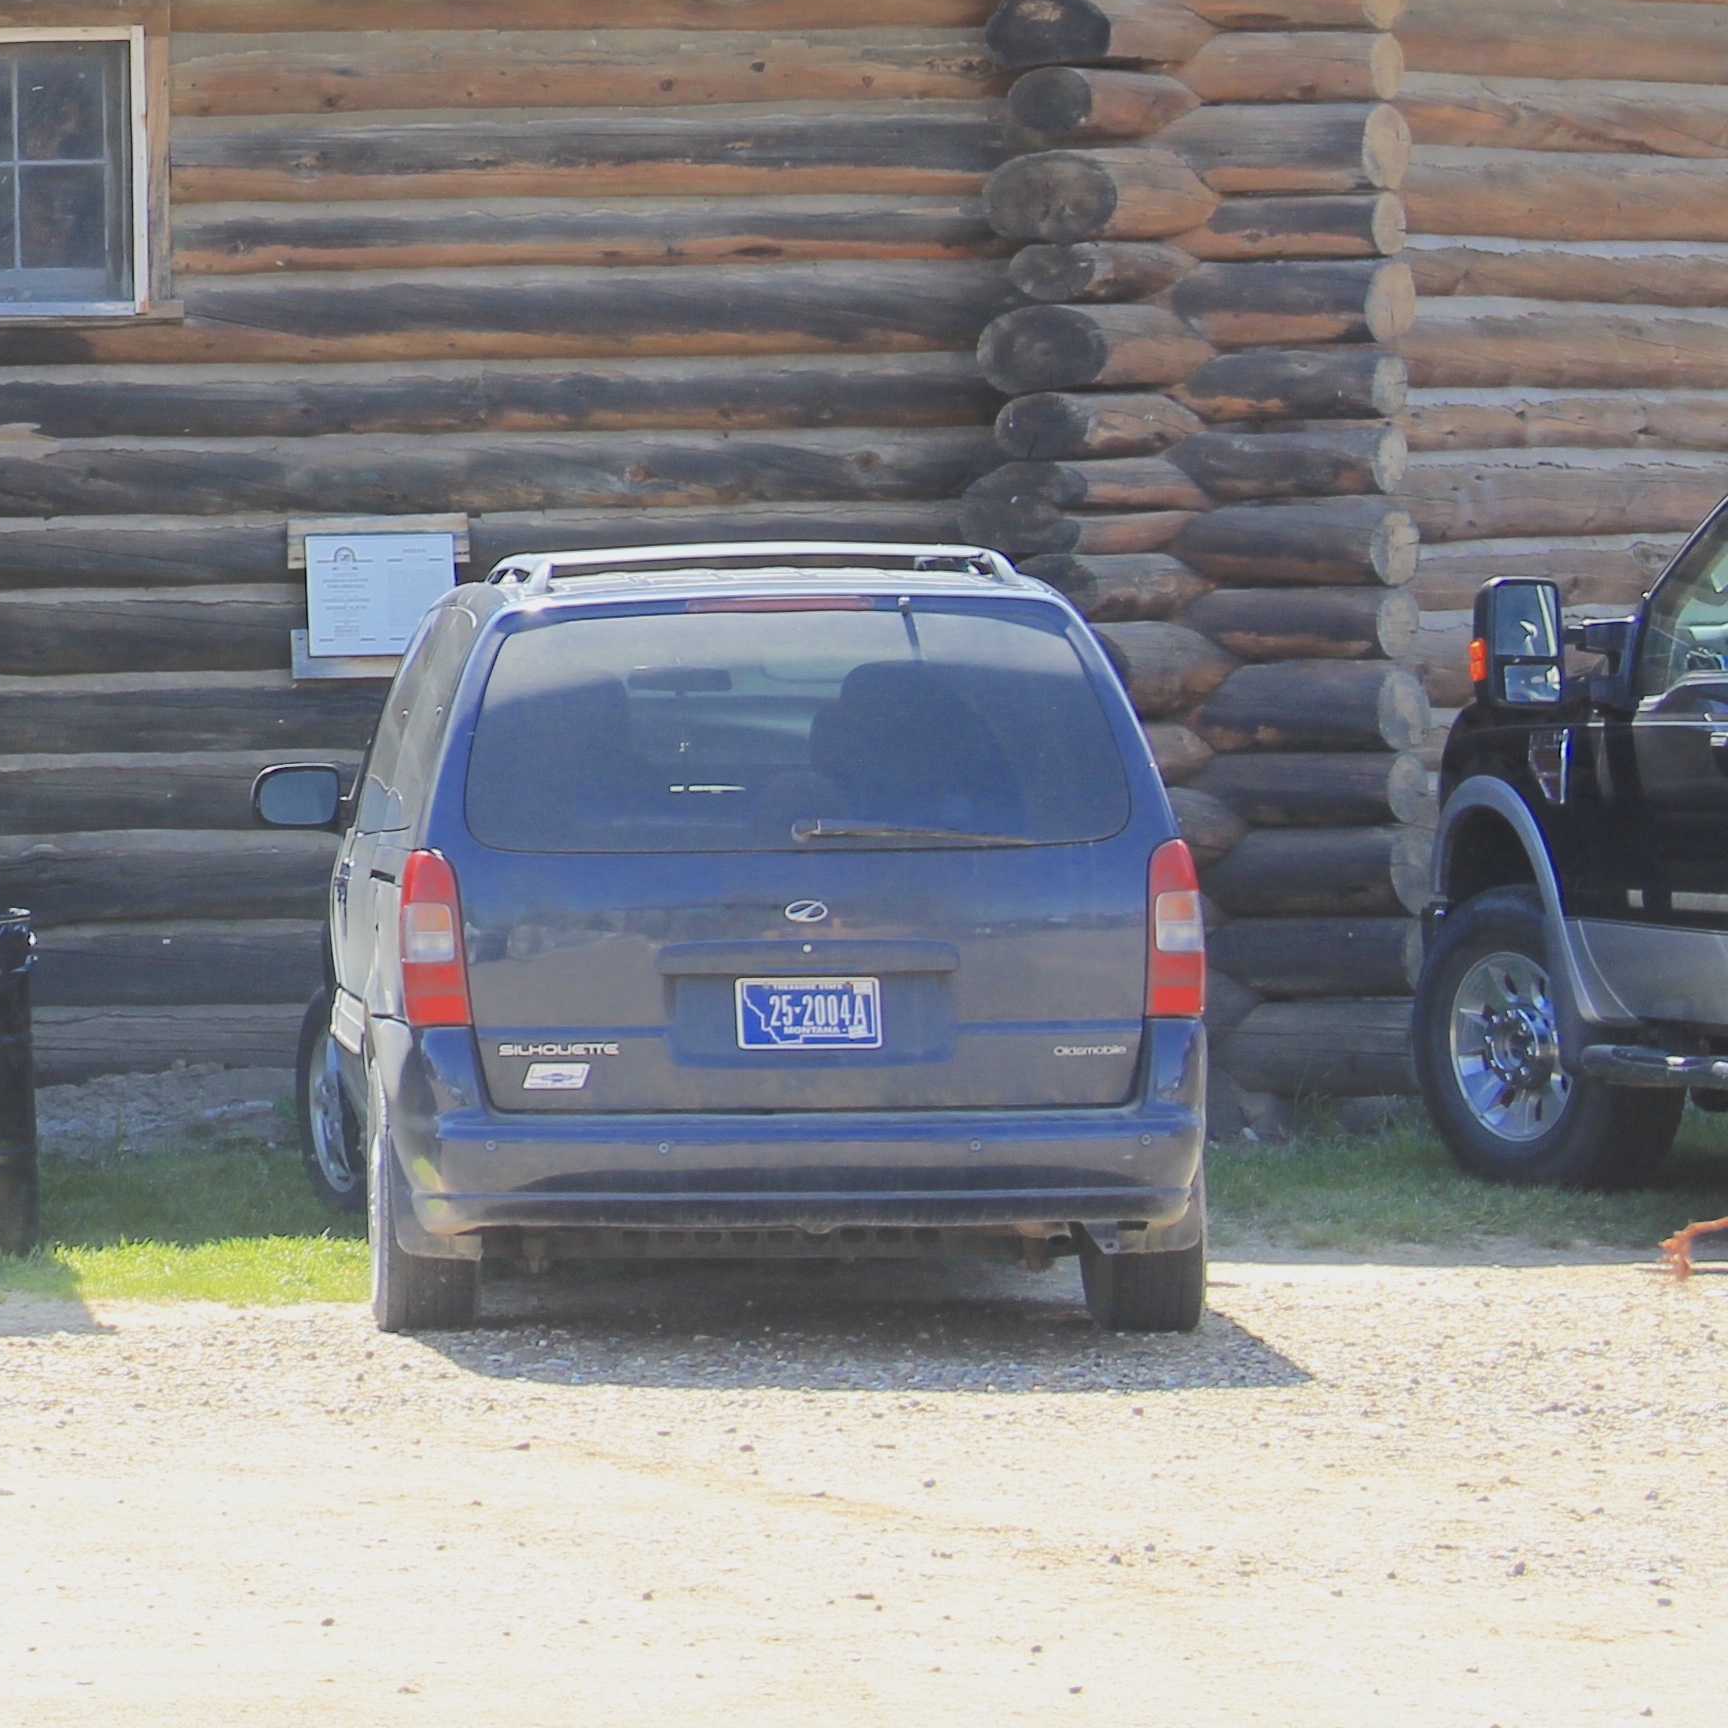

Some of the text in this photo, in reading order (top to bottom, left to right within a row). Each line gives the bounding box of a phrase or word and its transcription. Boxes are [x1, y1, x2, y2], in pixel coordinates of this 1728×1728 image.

[783, 1026, 841, 1034] MONTANA
[498, 1043, 620, 1056] SILHOUETTE
[1053, 1045, 1127, 1056] Oldsmobile
